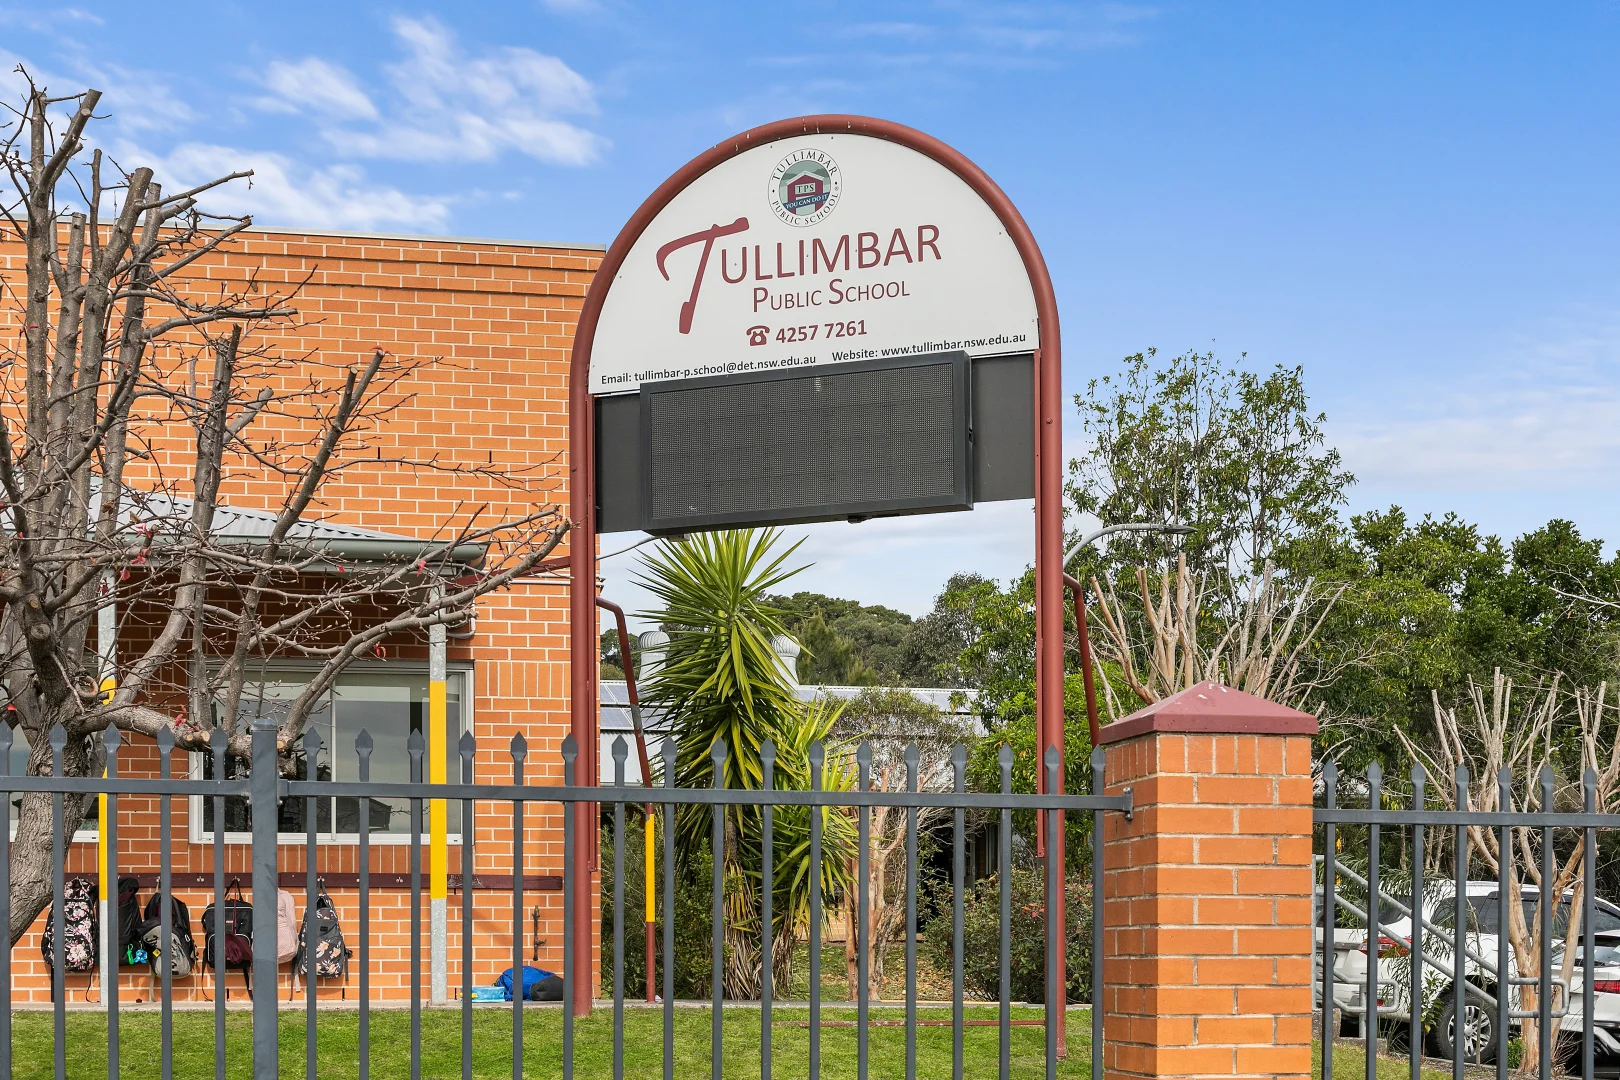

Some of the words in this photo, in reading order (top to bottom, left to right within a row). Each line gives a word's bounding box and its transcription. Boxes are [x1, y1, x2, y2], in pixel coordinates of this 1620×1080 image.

[772, 150, 838, 181] TULLIMBAR
[785, 201, 798, 210] YOU
[798, 198, 811, 206] CAN
[812, 195, 821, 203] DO
[796, 184, 814, 193] TPS
[772, 200, 801, 225] PUBLIC
[804, 193, 839, 225] SCHOOL
[656, 216, 942, 335] TULLIMBAR
[753, 286, 822, 313] PUBLIC
[828, 278, 910, 305] SCHOOL
[775, 325, 819, 344] 4257
[824, 319, 867, 339] 7261
[832, 348, 878, 362] Website:
[881, 333, 1026, 357] www.tullimbar.nsw.edu.au
[601, 373, 632, 385] Email:
[634, 355, 816, 382] tullimbar-p.school@det.nsw.edu.au
